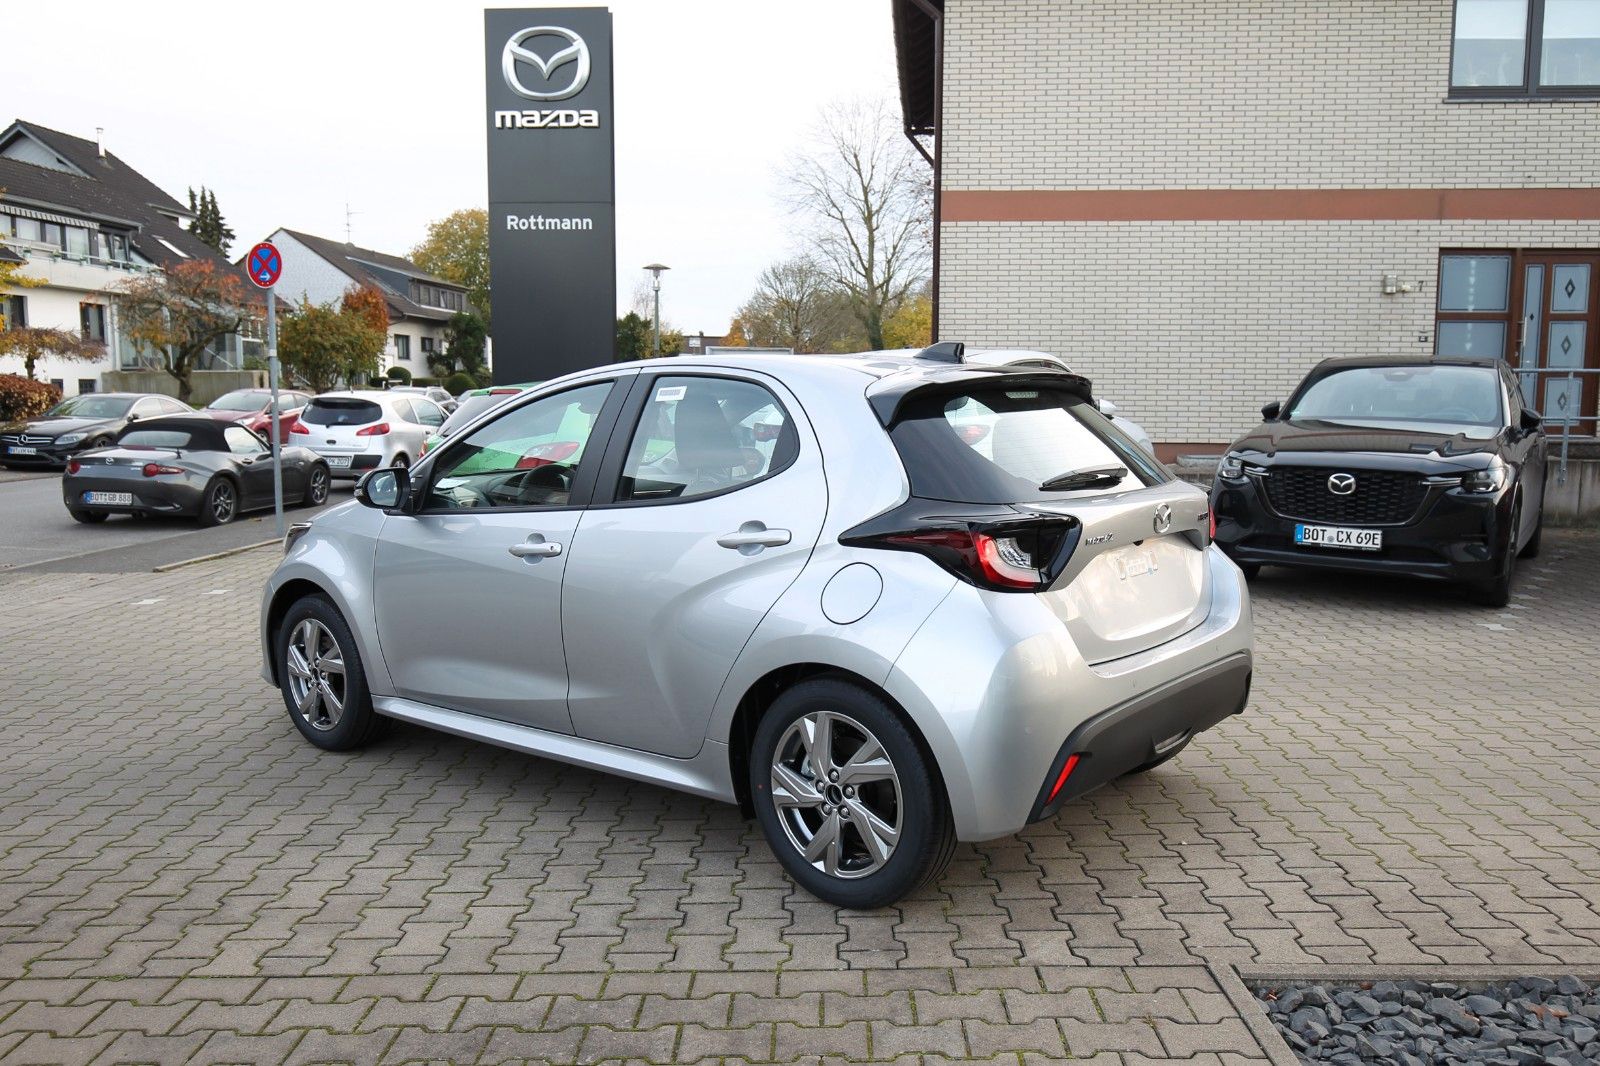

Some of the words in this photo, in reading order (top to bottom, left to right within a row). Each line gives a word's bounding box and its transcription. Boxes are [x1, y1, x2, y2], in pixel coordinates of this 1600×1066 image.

[506, 215, 593, 230] Rottmann
[90, 493, 104, 502] BOT
[108, 493, 117, 502] GB
[118, 494, 132, 503] 888
[1303, 527, 1327, 541] BOT
[1336, 530, 1352, 544] CX
[1356, 532, 1380, 546] 69E
